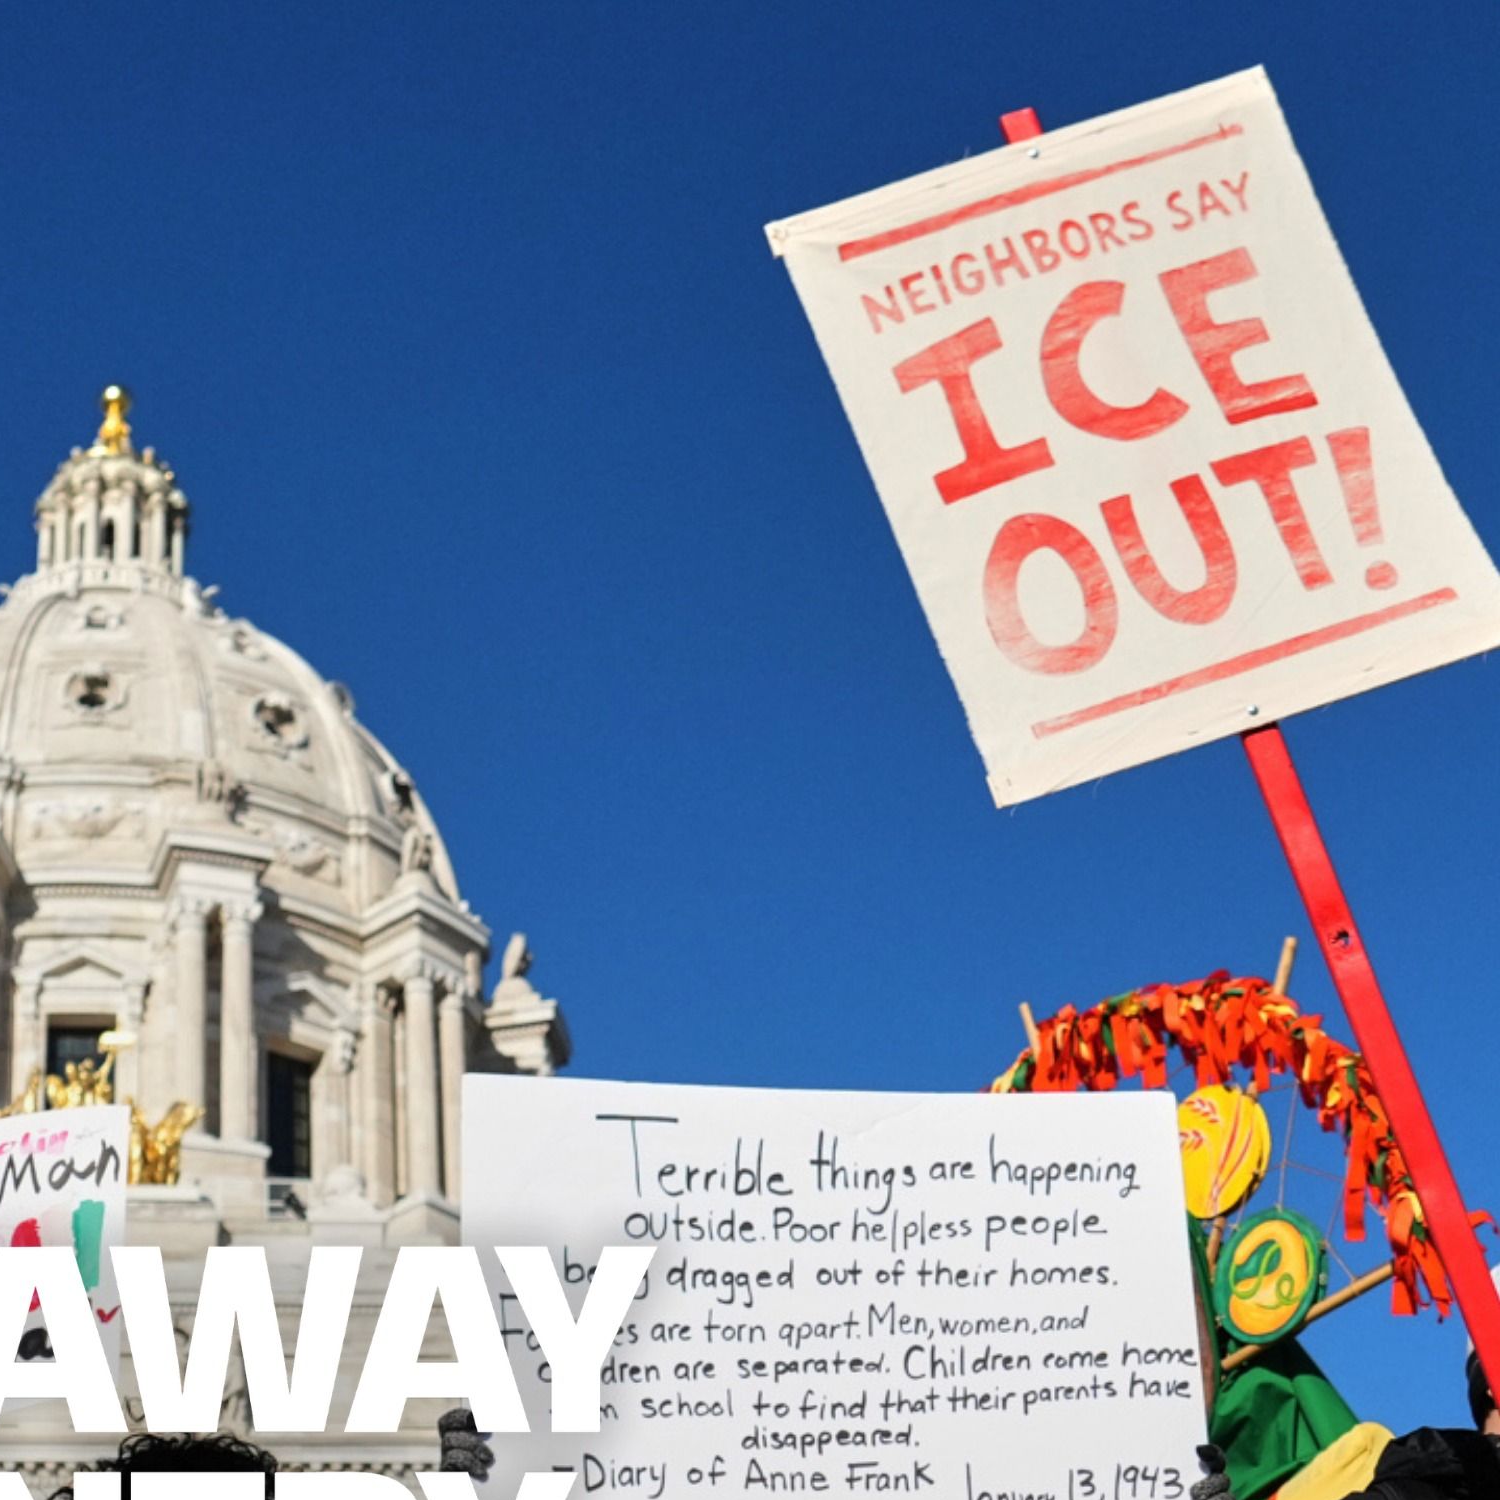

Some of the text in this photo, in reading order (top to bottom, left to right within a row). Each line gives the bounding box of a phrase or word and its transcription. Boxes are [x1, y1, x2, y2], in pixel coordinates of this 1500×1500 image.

[860, 171, 1252, 334] NEIGHBORS SAY
[891, 246, 1319, 506] ICE
[982, 426, 1400, 677] OUT!
[595, 1114, 1141, 1215] Terrible things are happening
[624, 1204, 1108, 1253] outside. Poor helpless people
[666, 1257, 795, 1307] dragged
[816, 1259, 863, 1287] out
[876, 1258, 906, 1287] of
[917, 1260, 999, 1288] their
[1009, 1259, 1119, 1288] homes.
[651, 1321, 692, 1343] are
[703, 1308, 767, 1345] torn
[778, 1310, 862, 1349] apart.
[868, 1301, 936, 1341] Men,
[1040, 1305, 1089, 1332] and
[674, 1359, 716, 1381] are
[737, 1346, 891, 1388] separated.
[903, 1345, 1032, 1379] Children
[1042, 1348, 1110, 1370] come
[1121, 1342, 1197, 1368] home
[641, 1390, 734, 1419] school
[752, 1391, 790, 1418] to
[799, 1389, 867, 1420] find
[880, 1388, 940, 1422] that
[947, 1385, 1016, 1413] their
[1021, 1377, 1118, 1416] parents
[1128, 1367, 1192, 1399] have
[741, 1423, 920, 1458] disappeared.
[687, 1455, 727, 1486] of
[744, 1458, 830, 1492] Anne
[845, 1461, 935, 1493] Frank
